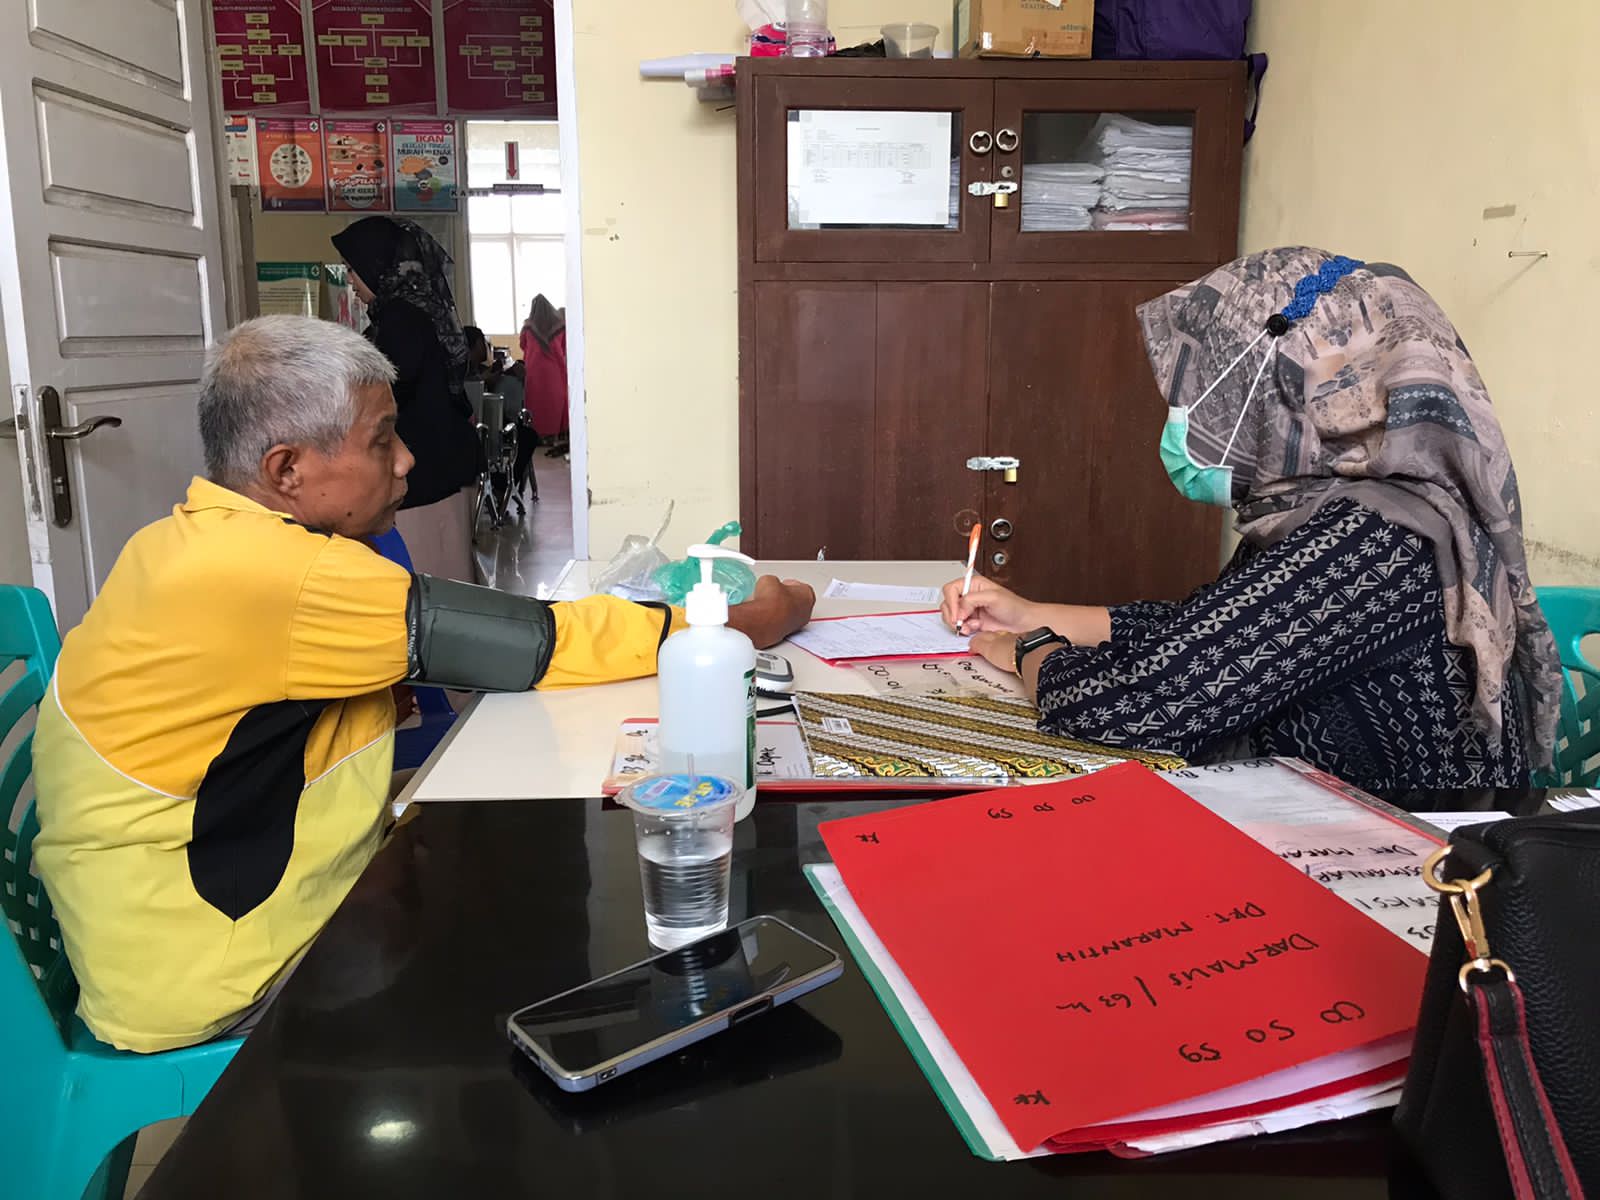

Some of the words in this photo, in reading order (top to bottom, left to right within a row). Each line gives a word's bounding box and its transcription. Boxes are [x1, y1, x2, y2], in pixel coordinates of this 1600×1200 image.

[415, 135, 444, 143] IKAN
[1098, 992, 1132, 1009] 63
[1177, 1041, 1222, 1065] 59
